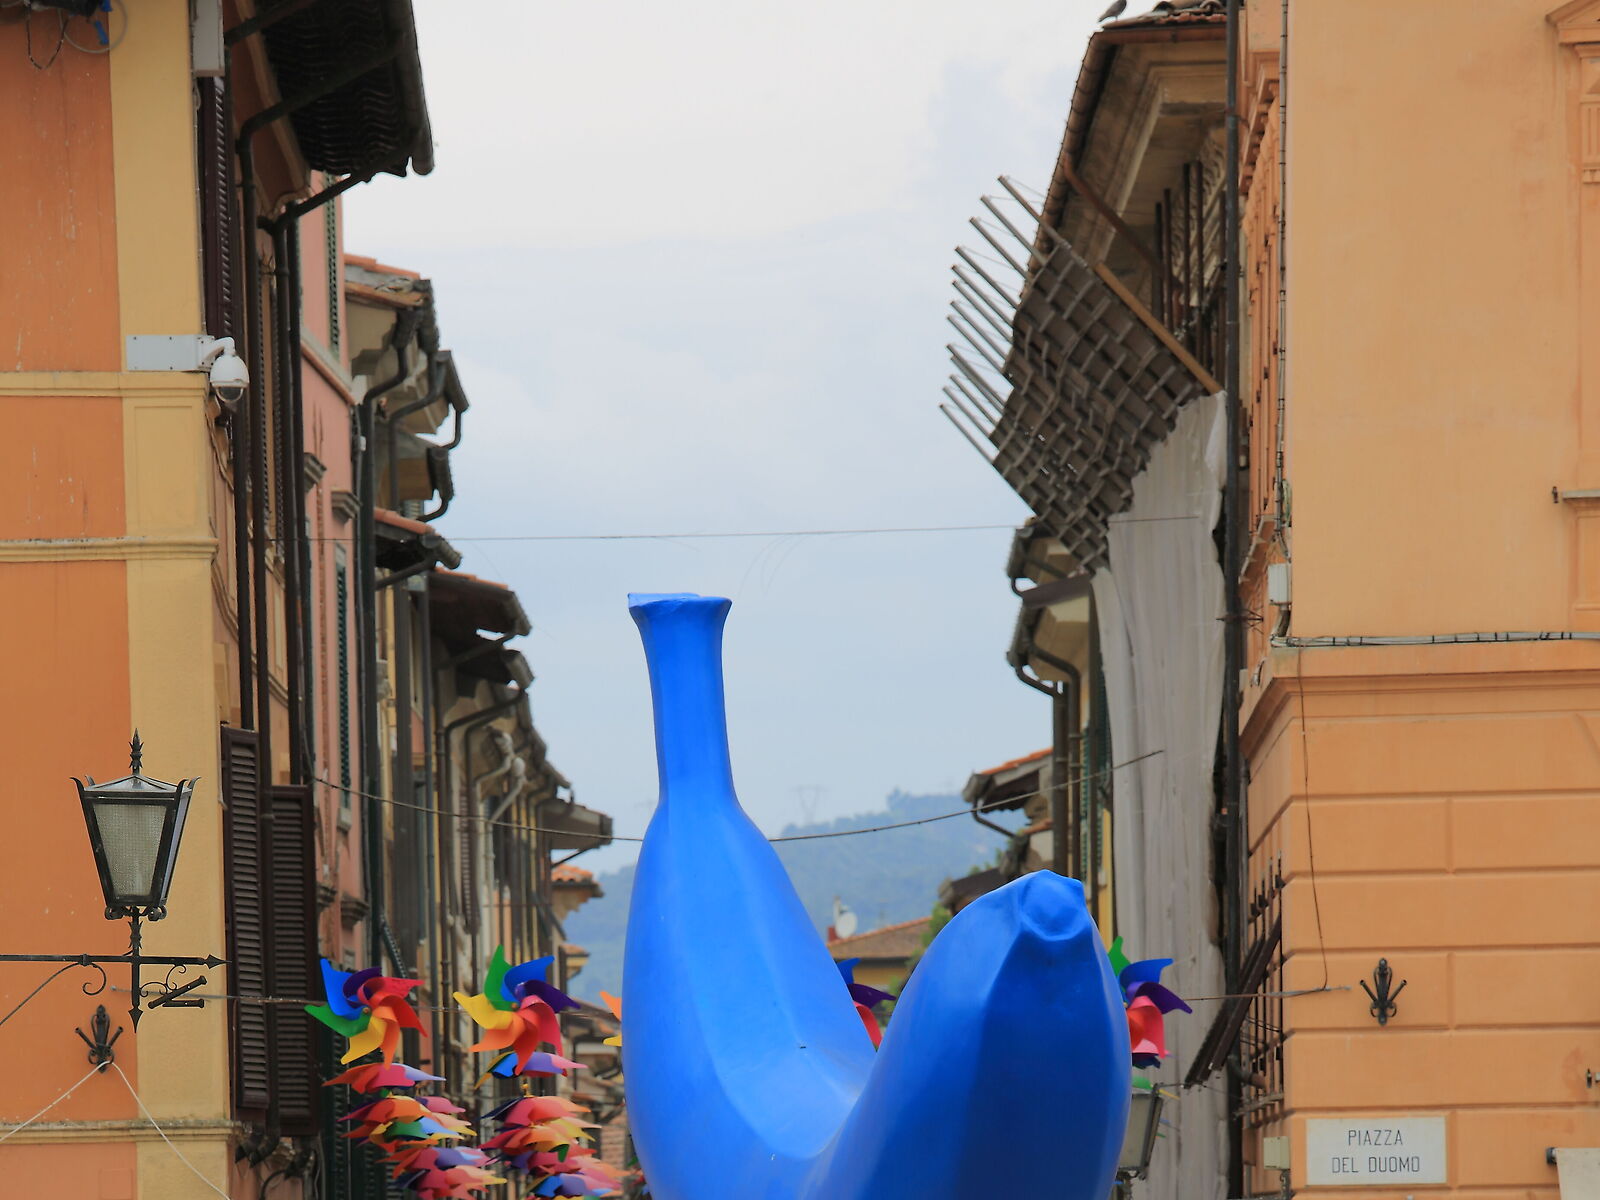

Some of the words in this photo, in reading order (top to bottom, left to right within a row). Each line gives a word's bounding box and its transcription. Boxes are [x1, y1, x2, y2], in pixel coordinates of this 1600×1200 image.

[1348, 1129, 1403, 1146] PIAZZA
[1331, 1157, 1360, 1173] DEL
[1368, 1156, 1420, 1173] DUOMO
